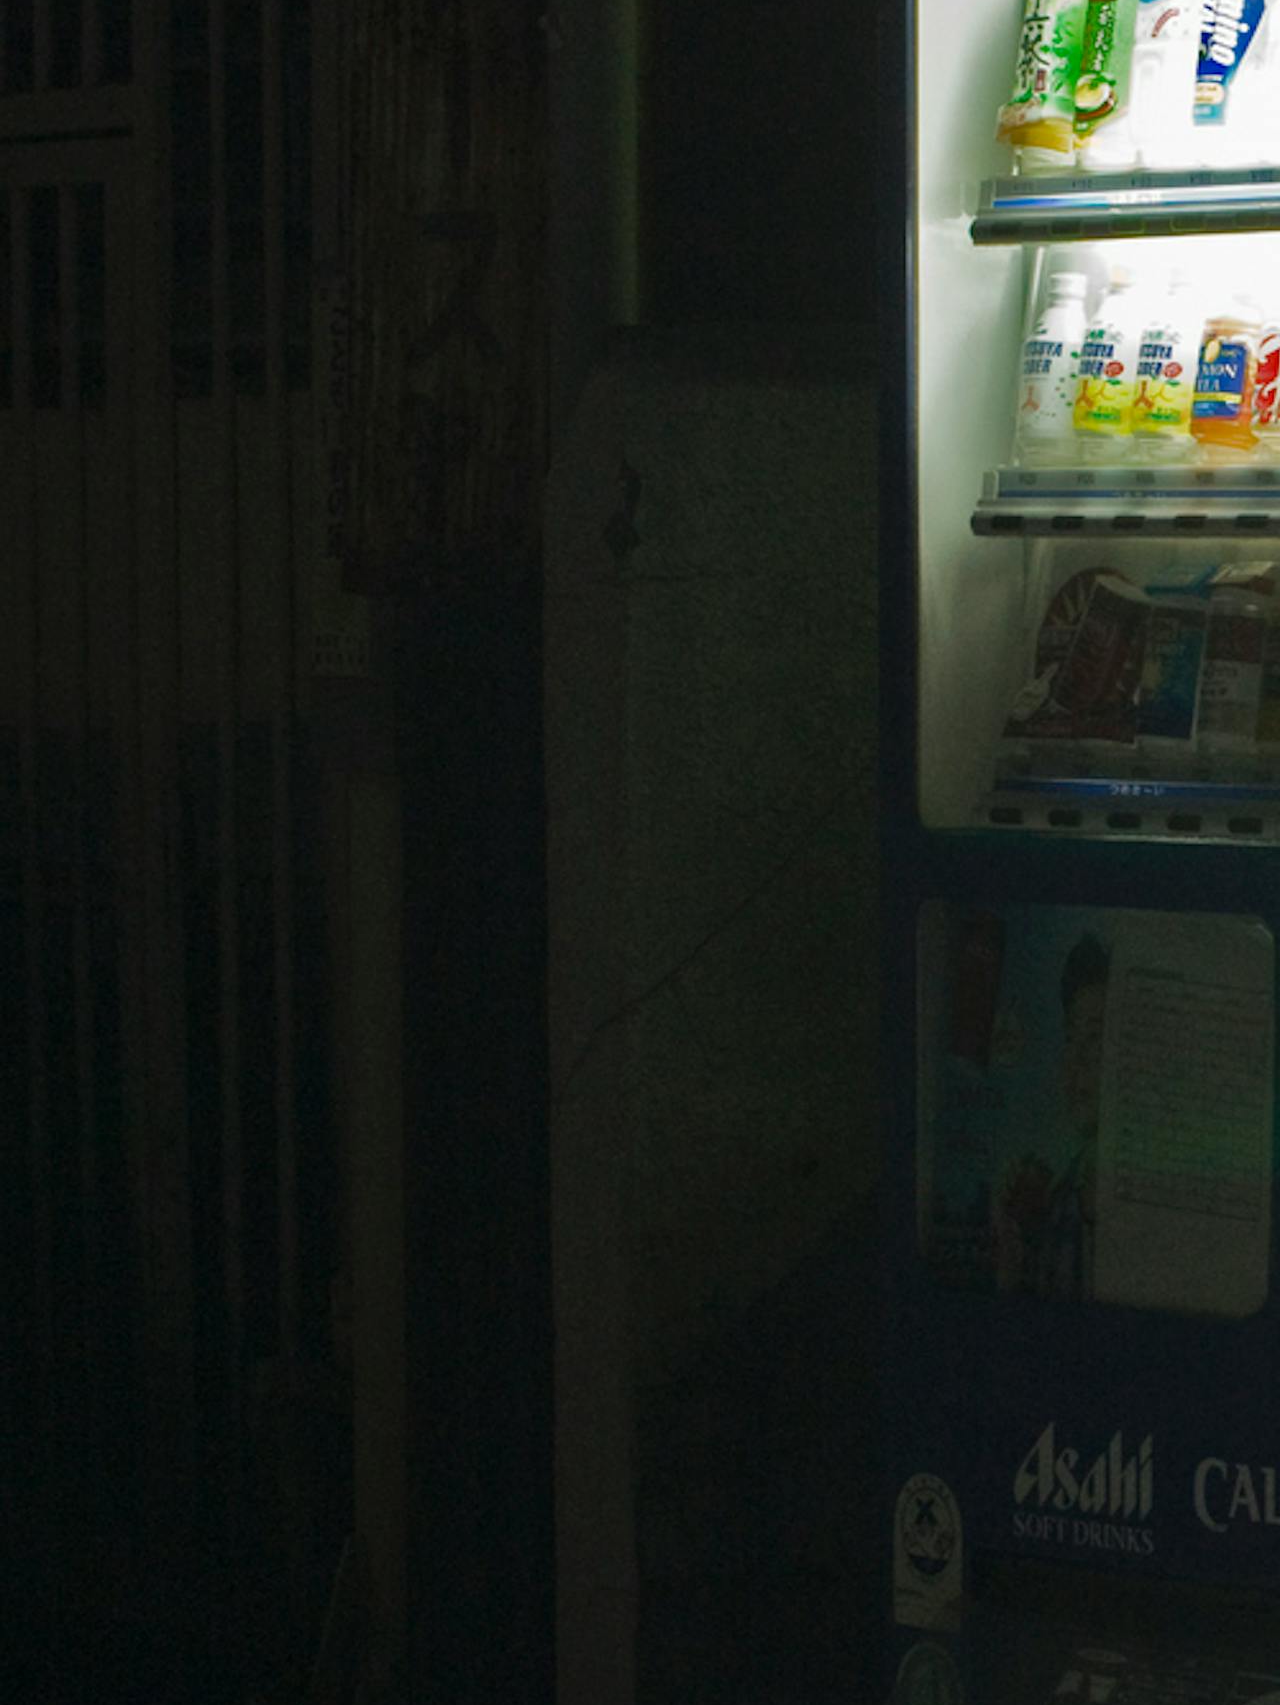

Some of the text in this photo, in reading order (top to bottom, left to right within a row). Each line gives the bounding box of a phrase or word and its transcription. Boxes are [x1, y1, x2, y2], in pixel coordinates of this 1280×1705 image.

[1013, 1421, 1155, 1519] Asahi
[1012, 1513, 1155, 1554] SOFT DRINKS
